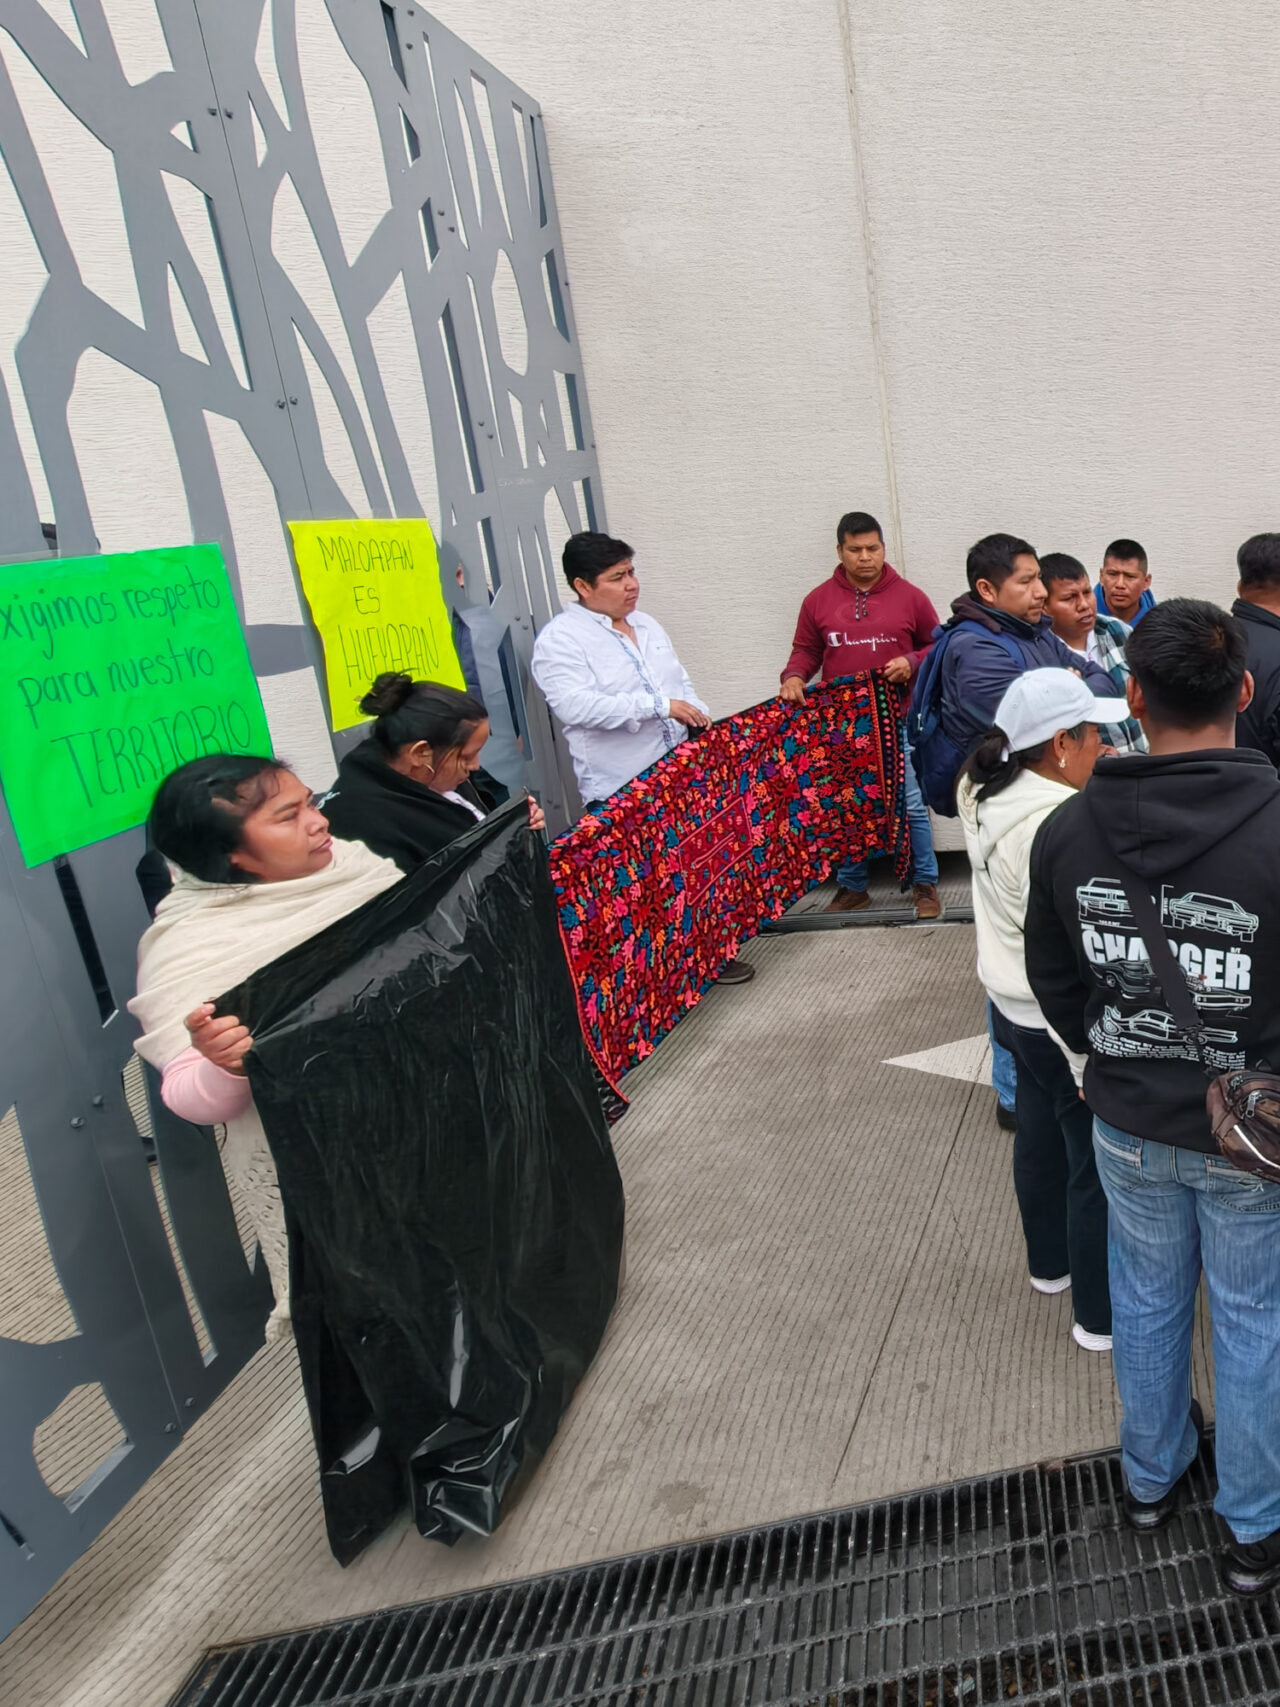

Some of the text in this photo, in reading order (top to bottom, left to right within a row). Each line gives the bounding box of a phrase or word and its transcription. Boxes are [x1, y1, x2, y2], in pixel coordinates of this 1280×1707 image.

[316, 535, 414, 574] MALOAPAN
[122, 565, 221, 628] respeto
[353, 585, 381, 615] ES
[828, 631, 898, 652] Champion
[17, 637, 215, 730] para nuestro
[50, 701, 251, 808] TERRITORIO
[1081, 929, 1253, 991] CHAGER
